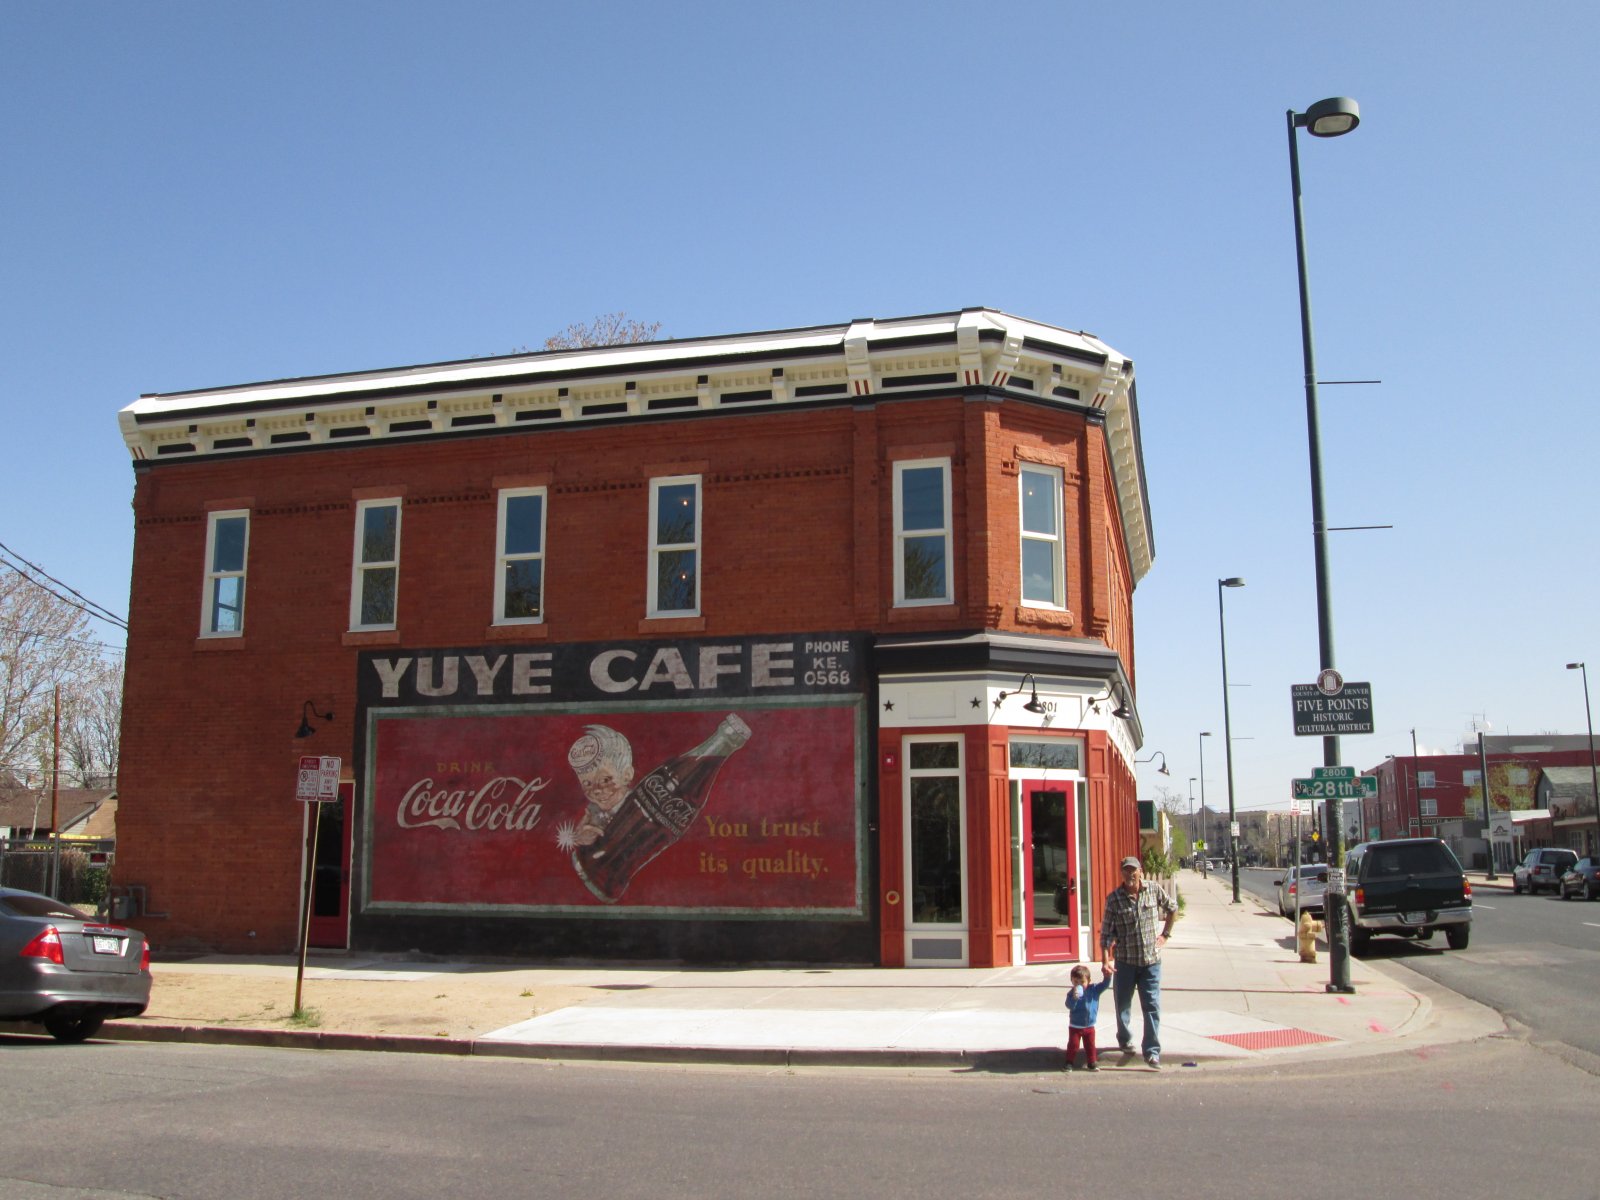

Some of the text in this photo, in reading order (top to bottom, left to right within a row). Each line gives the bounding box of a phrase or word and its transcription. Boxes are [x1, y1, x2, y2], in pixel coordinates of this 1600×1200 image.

[805, 640, 850, 654] PHONE
[813, 656, 842, 669] KE.
[371, 642, 795, 698] YUYE CAFE
[804, 670, 850, 686] 0568
[1344, 688, 1369, 696] DENVER
[1041, 701, 1058, 713] 801
[1296, 698, 1369, 712] FIVE POINTS
[1312, 712, 1354, 722] HISTORIC
[1297, 723, 1371, 733] CULTURAL DISTRICT
[326, 760, 335, 769] NO
[436, 761, 497, 773] DRINK
[1322, 768, 1347, 777] 2800
[1313, 780, 1353, 797] 28th
[397, 777, 552, 831] Coca-Cola
[705, 815, 823, 838] You trust
[700, 850, 830, 878] its quality.
